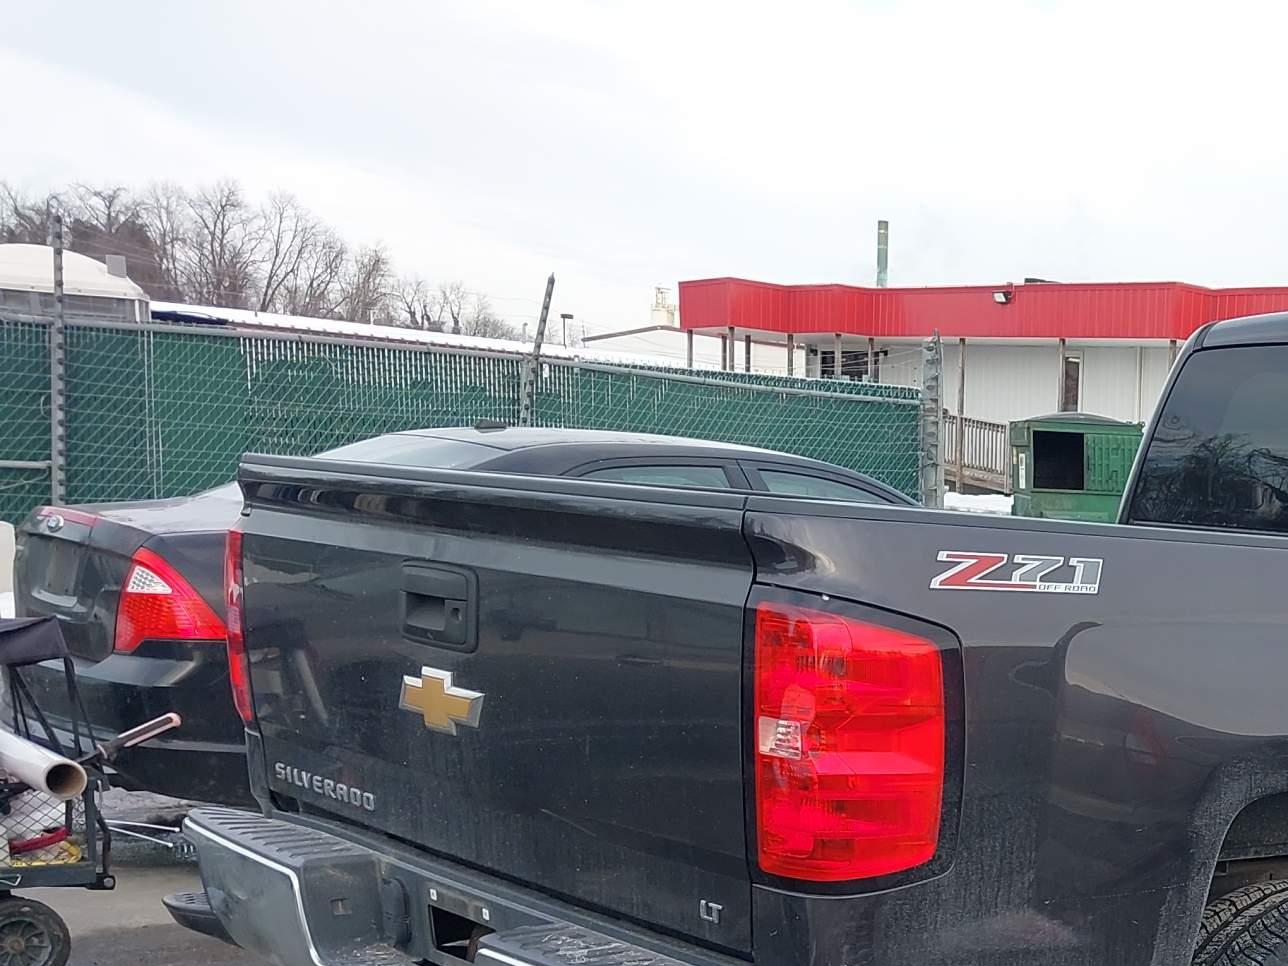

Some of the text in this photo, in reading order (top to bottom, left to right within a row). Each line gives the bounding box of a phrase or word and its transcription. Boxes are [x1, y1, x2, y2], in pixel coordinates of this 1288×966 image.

[929, 550, 1103, 590] Z71
[275, 762, 375, 811] SILVERADO
[700, 899, 723, 924] LT
